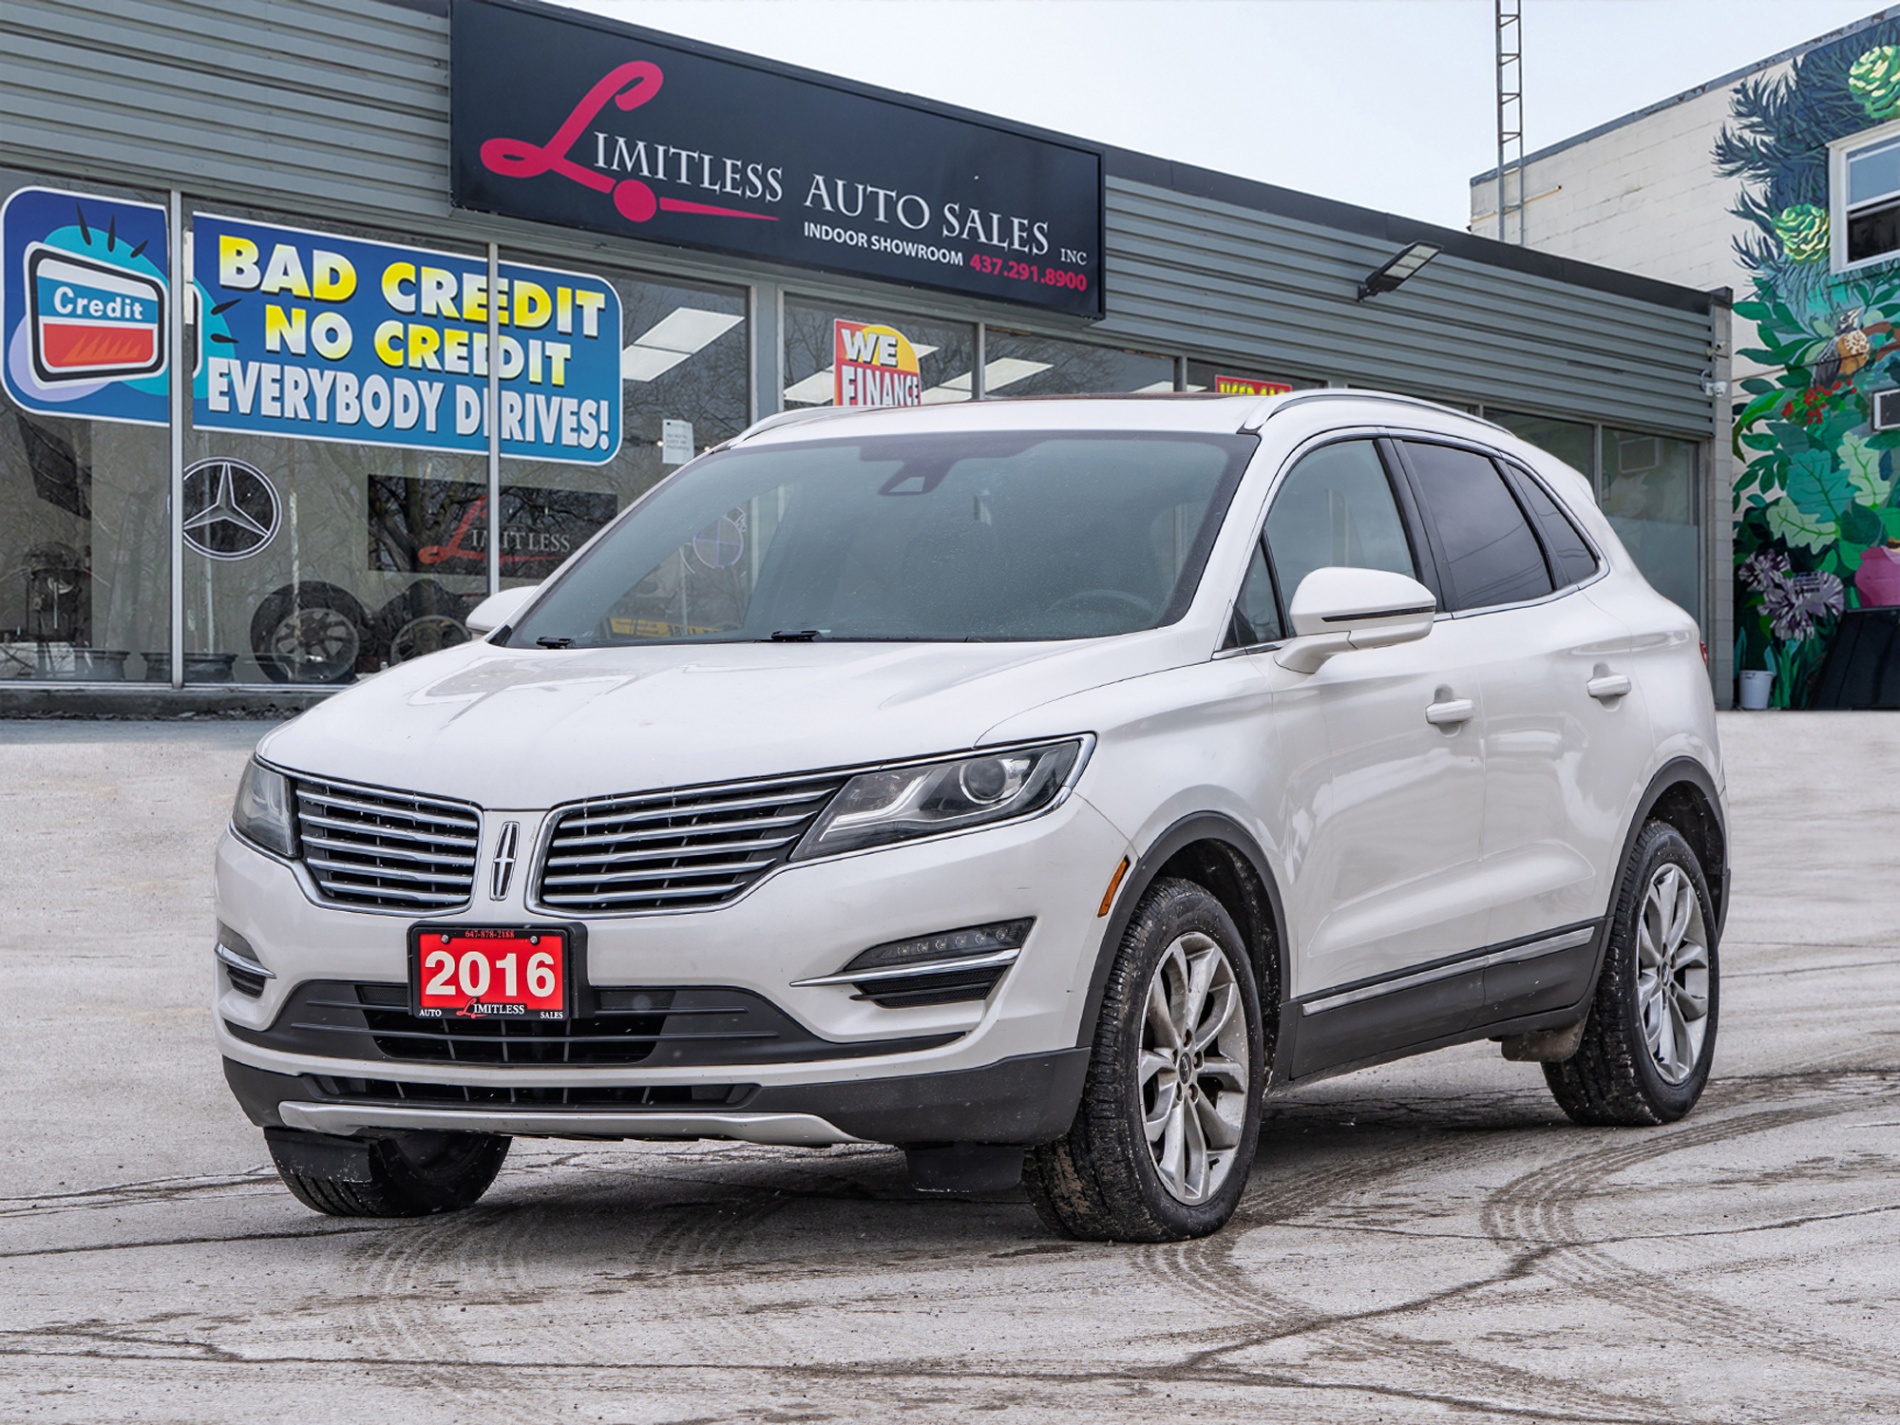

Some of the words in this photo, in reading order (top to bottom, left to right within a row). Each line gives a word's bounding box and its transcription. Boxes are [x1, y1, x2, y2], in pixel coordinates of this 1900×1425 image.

[480, 60, 783, 212] LIMITLESS
[803, 174, 930, 230] AUTO
[942, 203, 1049, 256] SALES
[1060, 248, 1087, 265] INC
[804, 221, 867, 248] INDOOR
[871, 235, 963, 266] SHOWROOM
[970, 253, 1087, 291] 437.291.8900
[54, 286, 143, 319] Credit
[219, 235, 357, 301] BAD
[382, 262, 605, 336] CREDIT
[265, 304, 353, 359] NO
[374, 320, 571, 385] CREDIT
[841, 328, 897, 367] WE
[208, 356, 444, 432] EVERYBODY
[456, 384, 609, 450] DRIVES!
[841, 365, 919, 406] FINANCE
[425, 950, 556, 997] 2016
[419, 1009, 442, 1017] AUTO
[456, 998, 525, 1018] LIMITLESS
[540, 1011, 563, 1019] SALES
